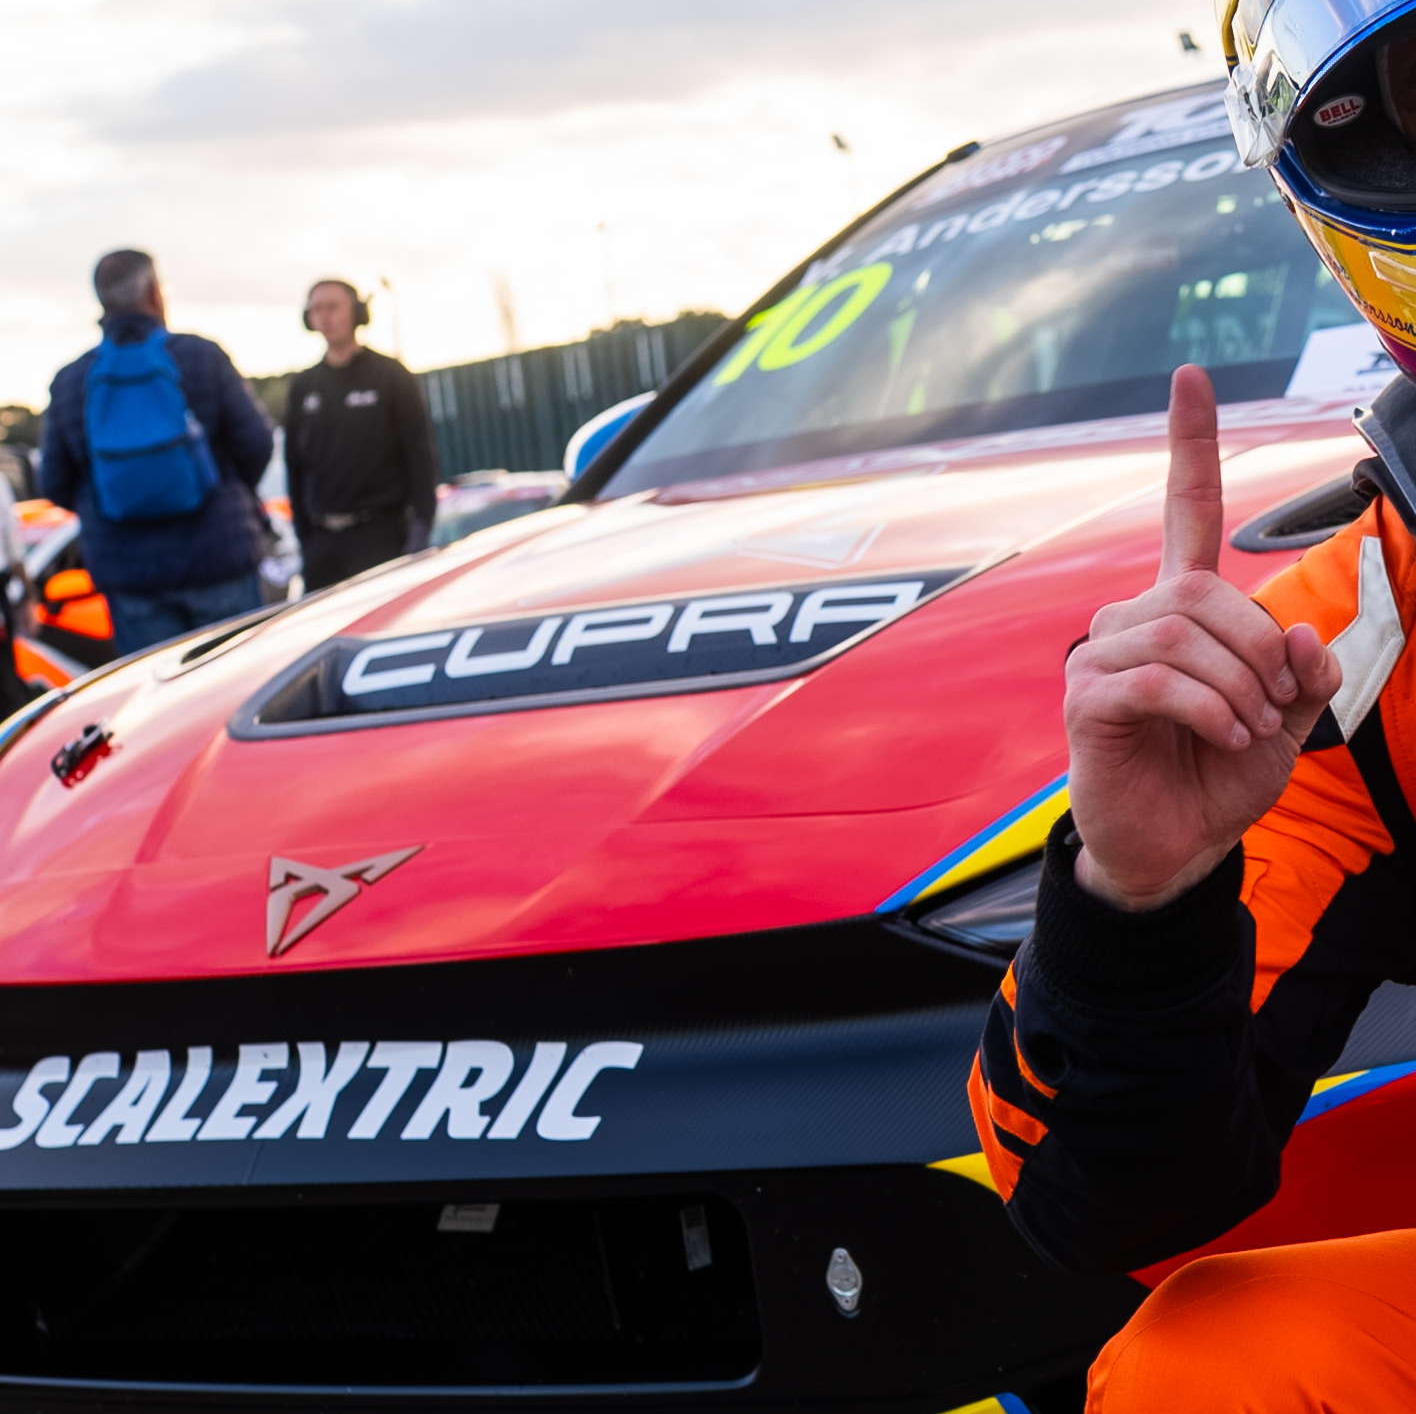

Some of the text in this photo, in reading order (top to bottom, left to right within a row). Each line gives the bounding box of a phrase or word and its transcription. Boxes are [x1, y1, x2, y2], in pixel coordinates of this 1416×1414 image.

[1319, 98, 1361, 123] BELL
[711, 261, 894, 388] 10
[341, 581, 925, 697] CUPRA
[0, 1040, 644, 1150] SCALEXTRIC
